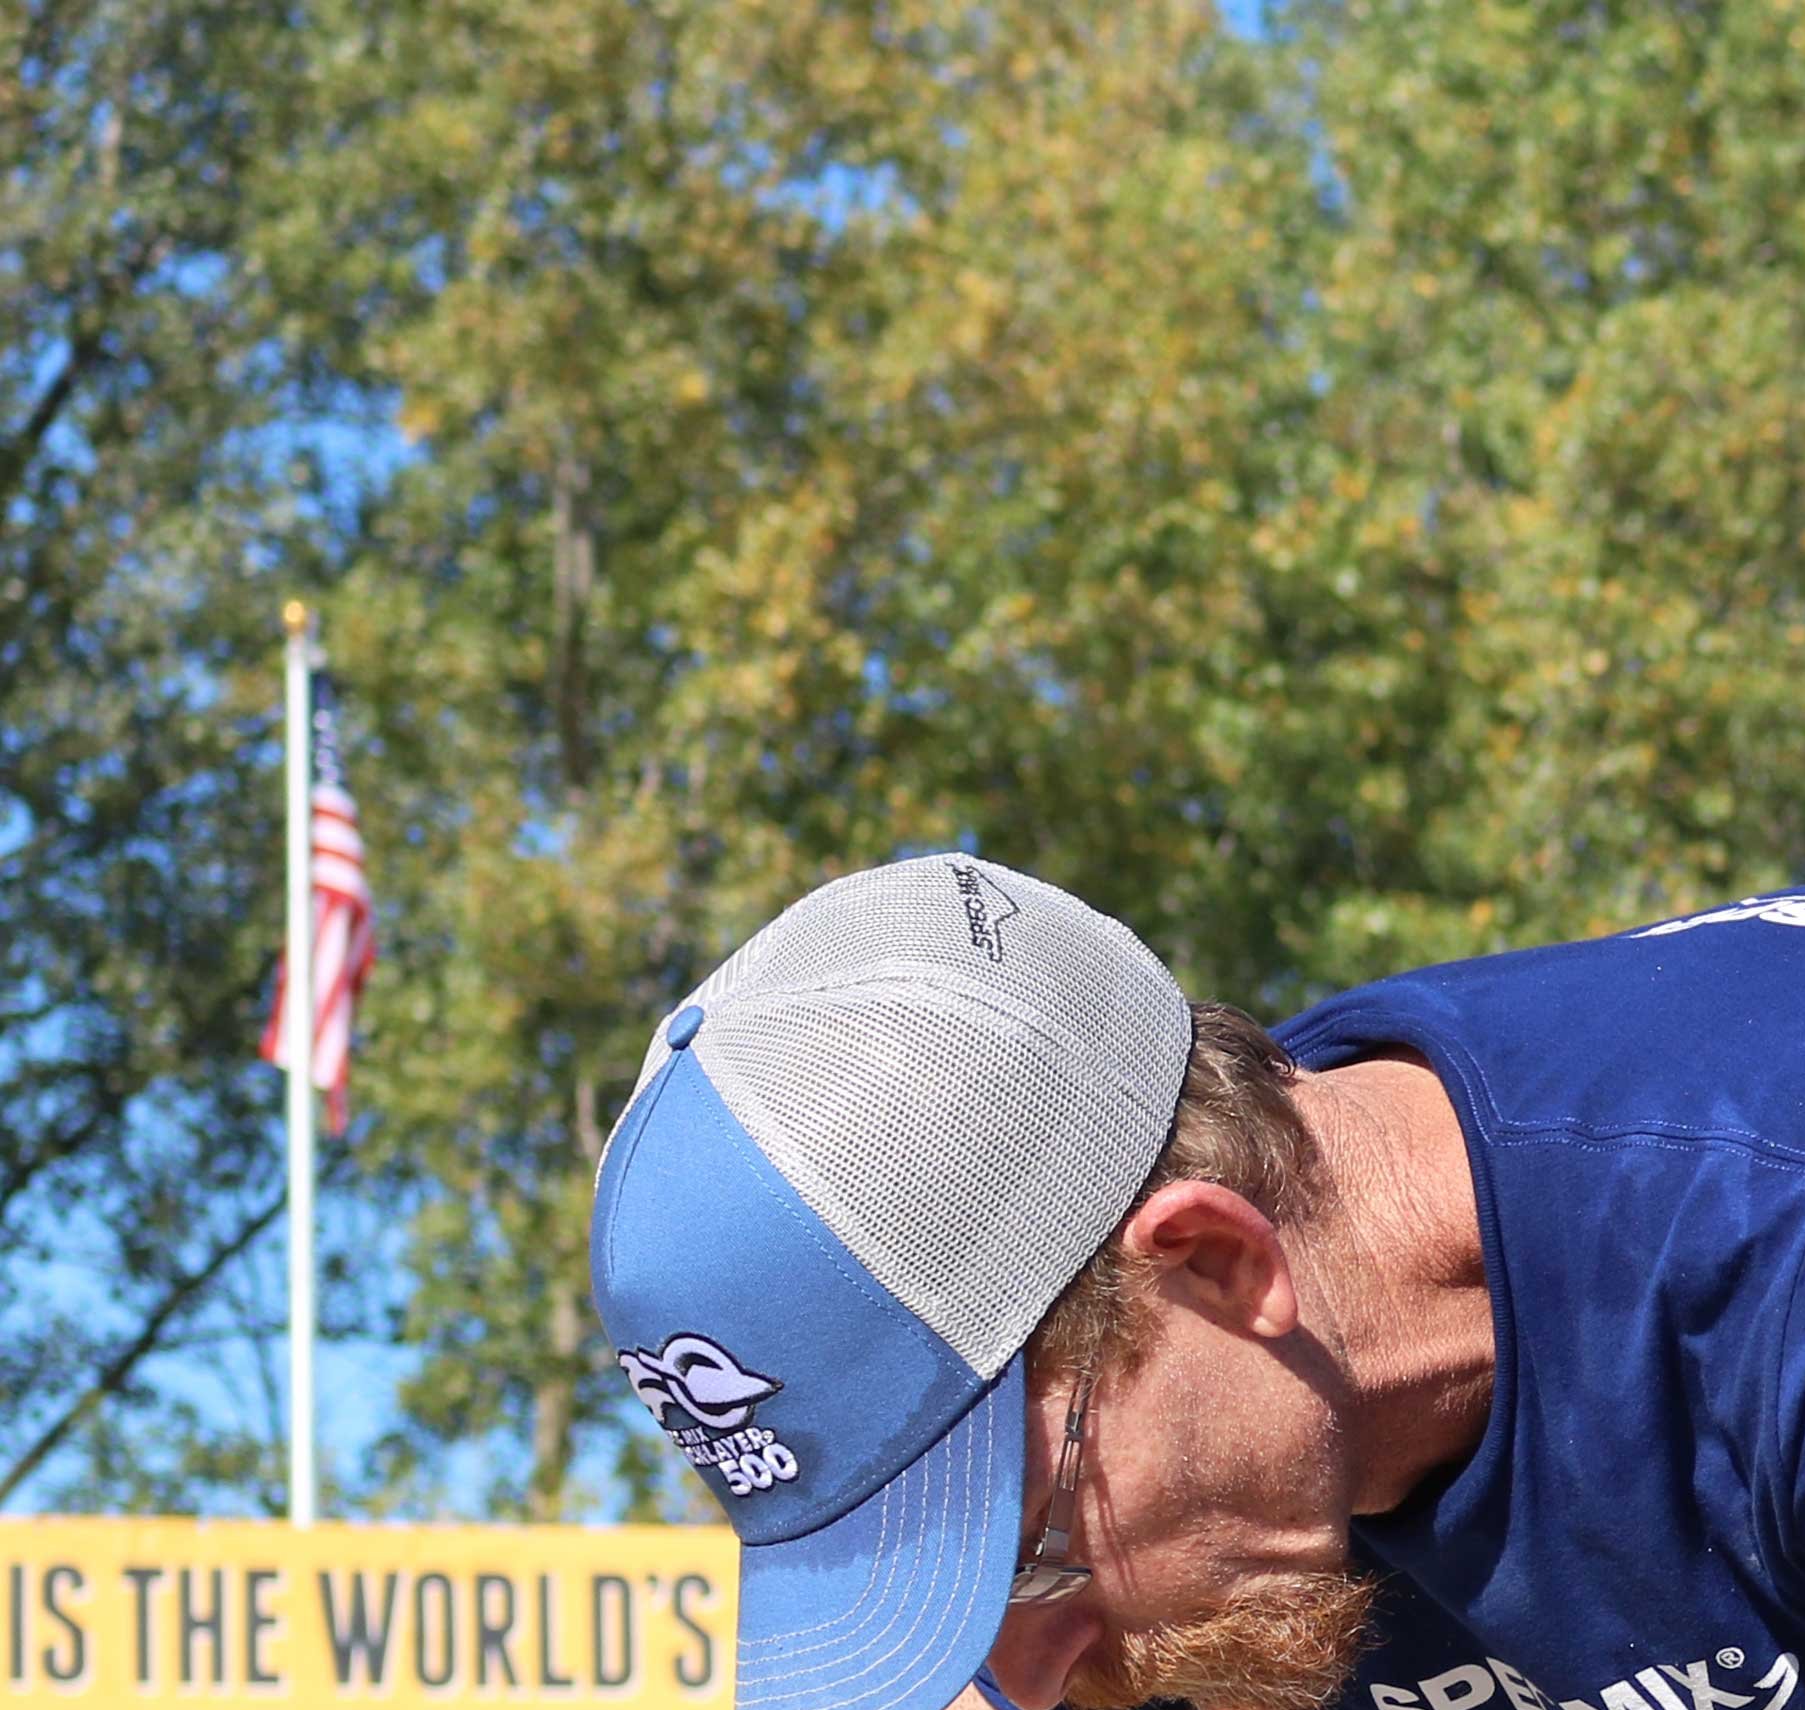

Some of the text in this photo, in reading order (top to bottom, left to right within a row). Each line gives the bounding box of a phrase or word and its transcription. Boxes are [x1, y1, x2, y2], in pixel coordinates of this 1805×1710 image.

[718, 1443, 798, 1495] 500
[10, 1565, 715, 1688] IS THE WORLD'S
